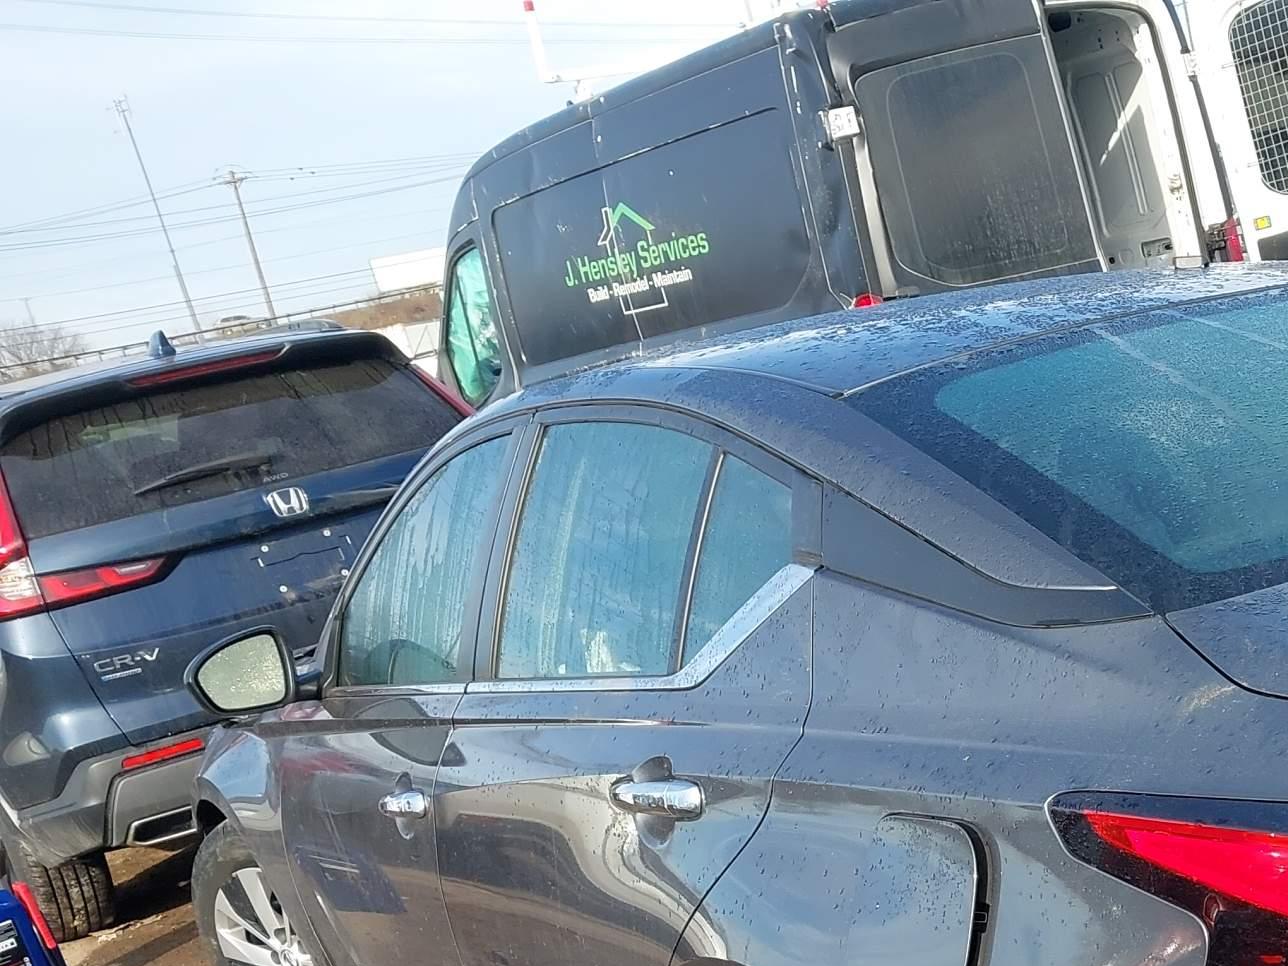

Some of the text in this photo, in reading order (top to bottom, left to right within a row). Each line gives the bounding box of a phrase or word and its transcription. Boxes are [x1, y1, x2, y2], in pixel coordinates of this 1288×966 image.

[565, 232, 709, 287] J. Hensley Services
[587, 266, 693, 303] Build Remodel Maintain
[94, 647, 159, 672] CR-V
